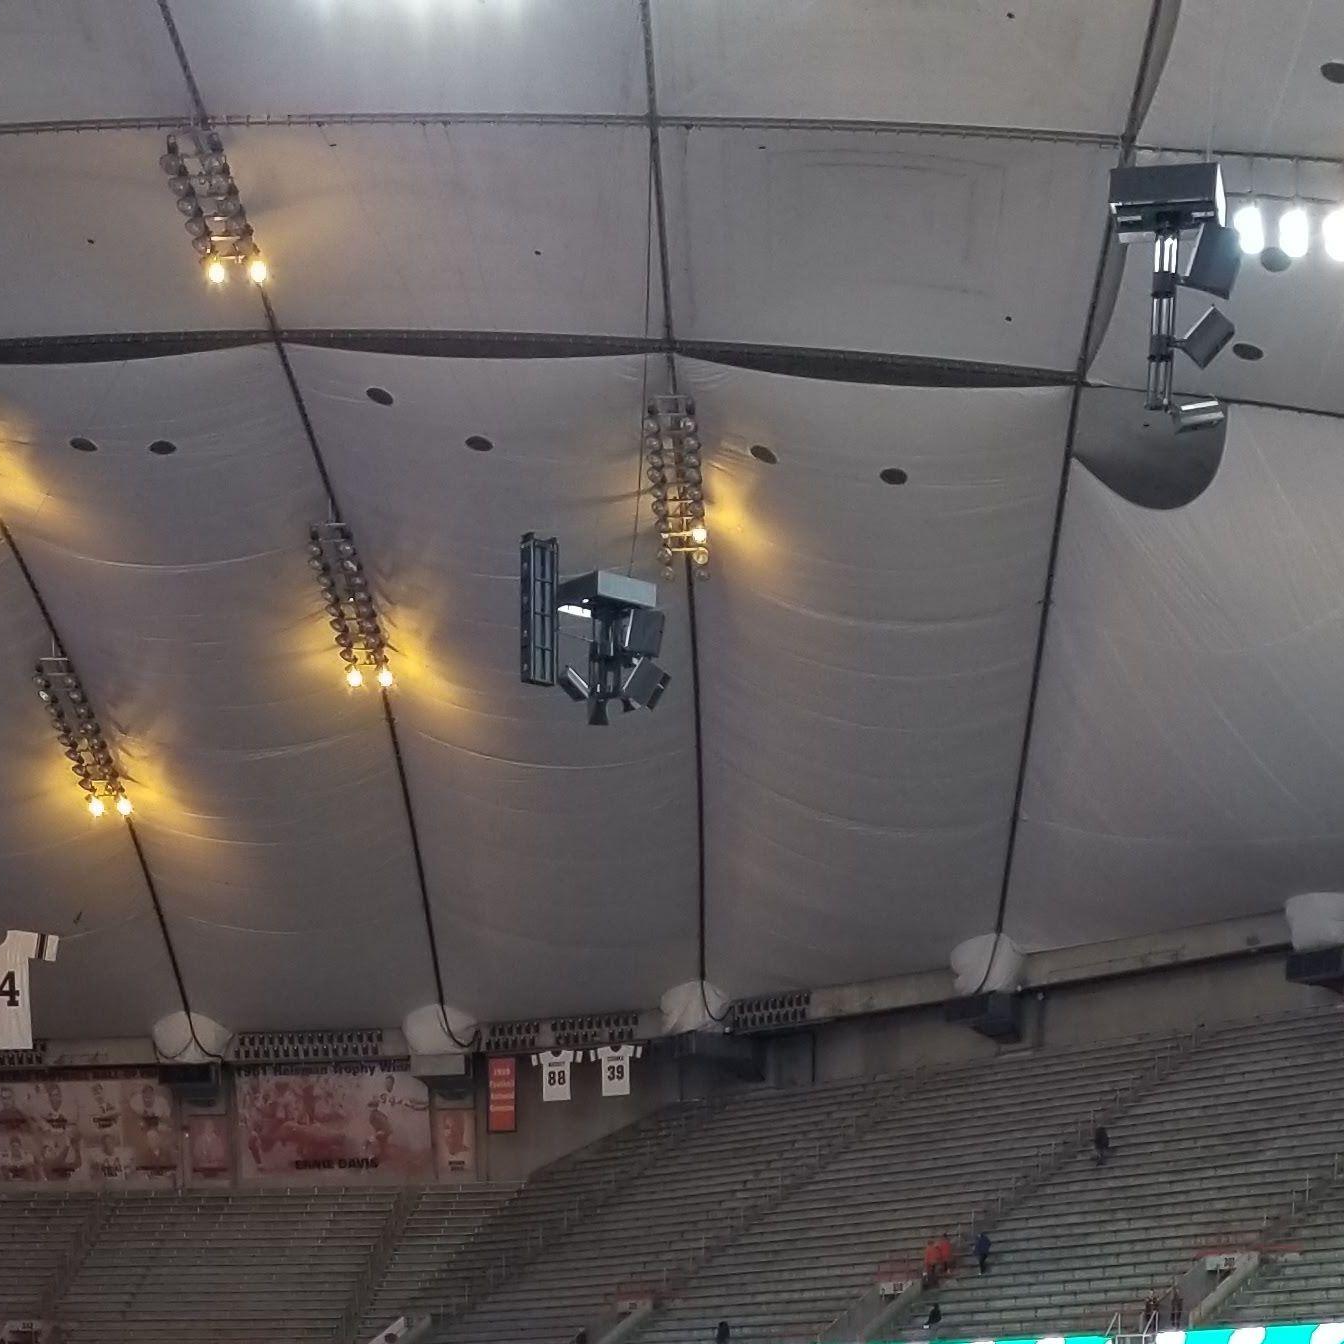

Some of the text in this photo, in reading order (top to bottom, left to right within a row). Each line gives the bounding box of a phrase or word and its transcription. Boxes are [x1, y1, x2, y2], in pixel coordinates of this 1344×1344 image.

[548, 1070, 566, 1086] 88
[607, 1064, 624, 1081] 39
[337, 1157, 381, 1169] DAVIS
